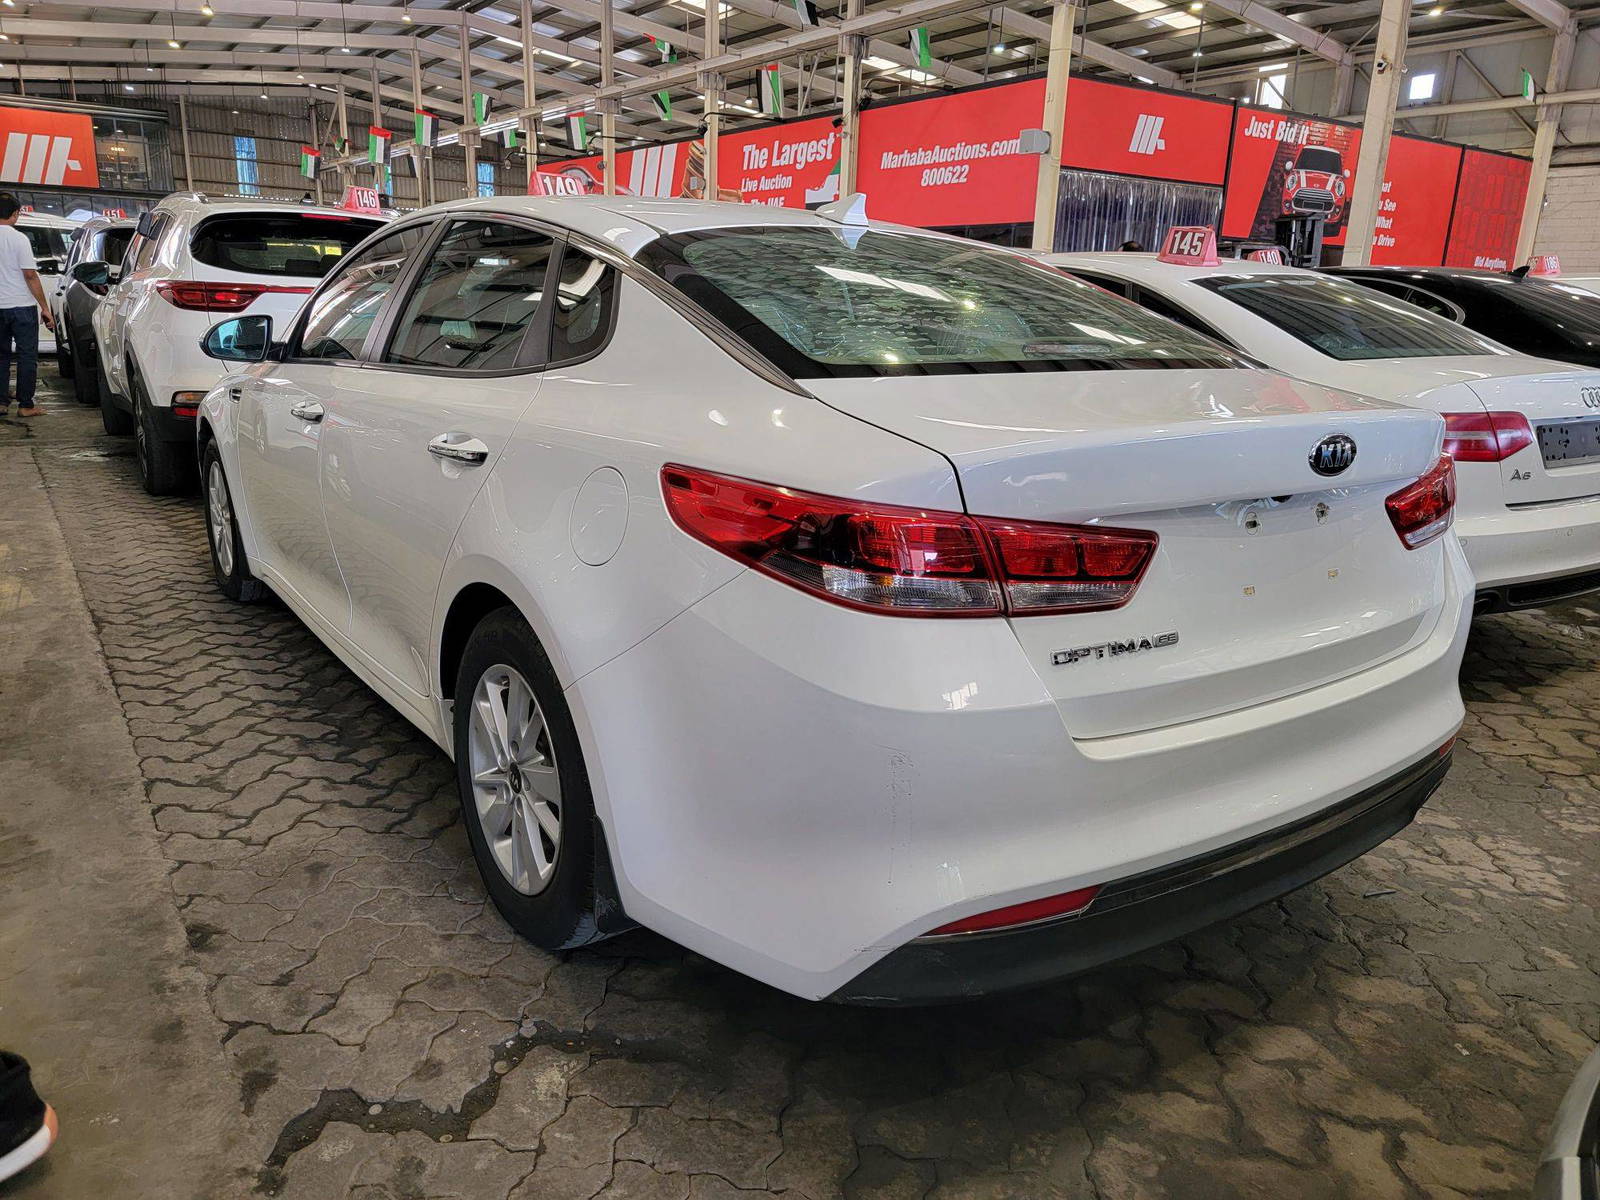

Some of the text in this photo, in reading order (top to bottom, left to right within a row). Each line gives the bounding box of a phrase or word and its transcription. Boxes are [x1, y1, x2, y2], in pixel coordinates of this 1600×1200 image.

[1245, 116, 1310, 145] Just Bid It
[743, 132, 835, 170] The Largest
[881, 138, 1020, 169] MarhabaAuctions.com
[544, 175, 578, 196] 149
[741, 174, 792, 192] Live Auction
[921, 165, 969, 186] 800622
[357, 190, 375, 207] 146
[1384, 199, 1396, 212] See
[107, 209, 120, 219] 151
[1173, 231, 1205, 256] 145
[1377, 234, 1395, 247] Drive
[1261, 251, 1279, 265] 140
[1320, 443, 1352, 468] KIA
[1510, 469, 1531, 480] A6
[1050, 638, 1152, 665] OPTIMA
